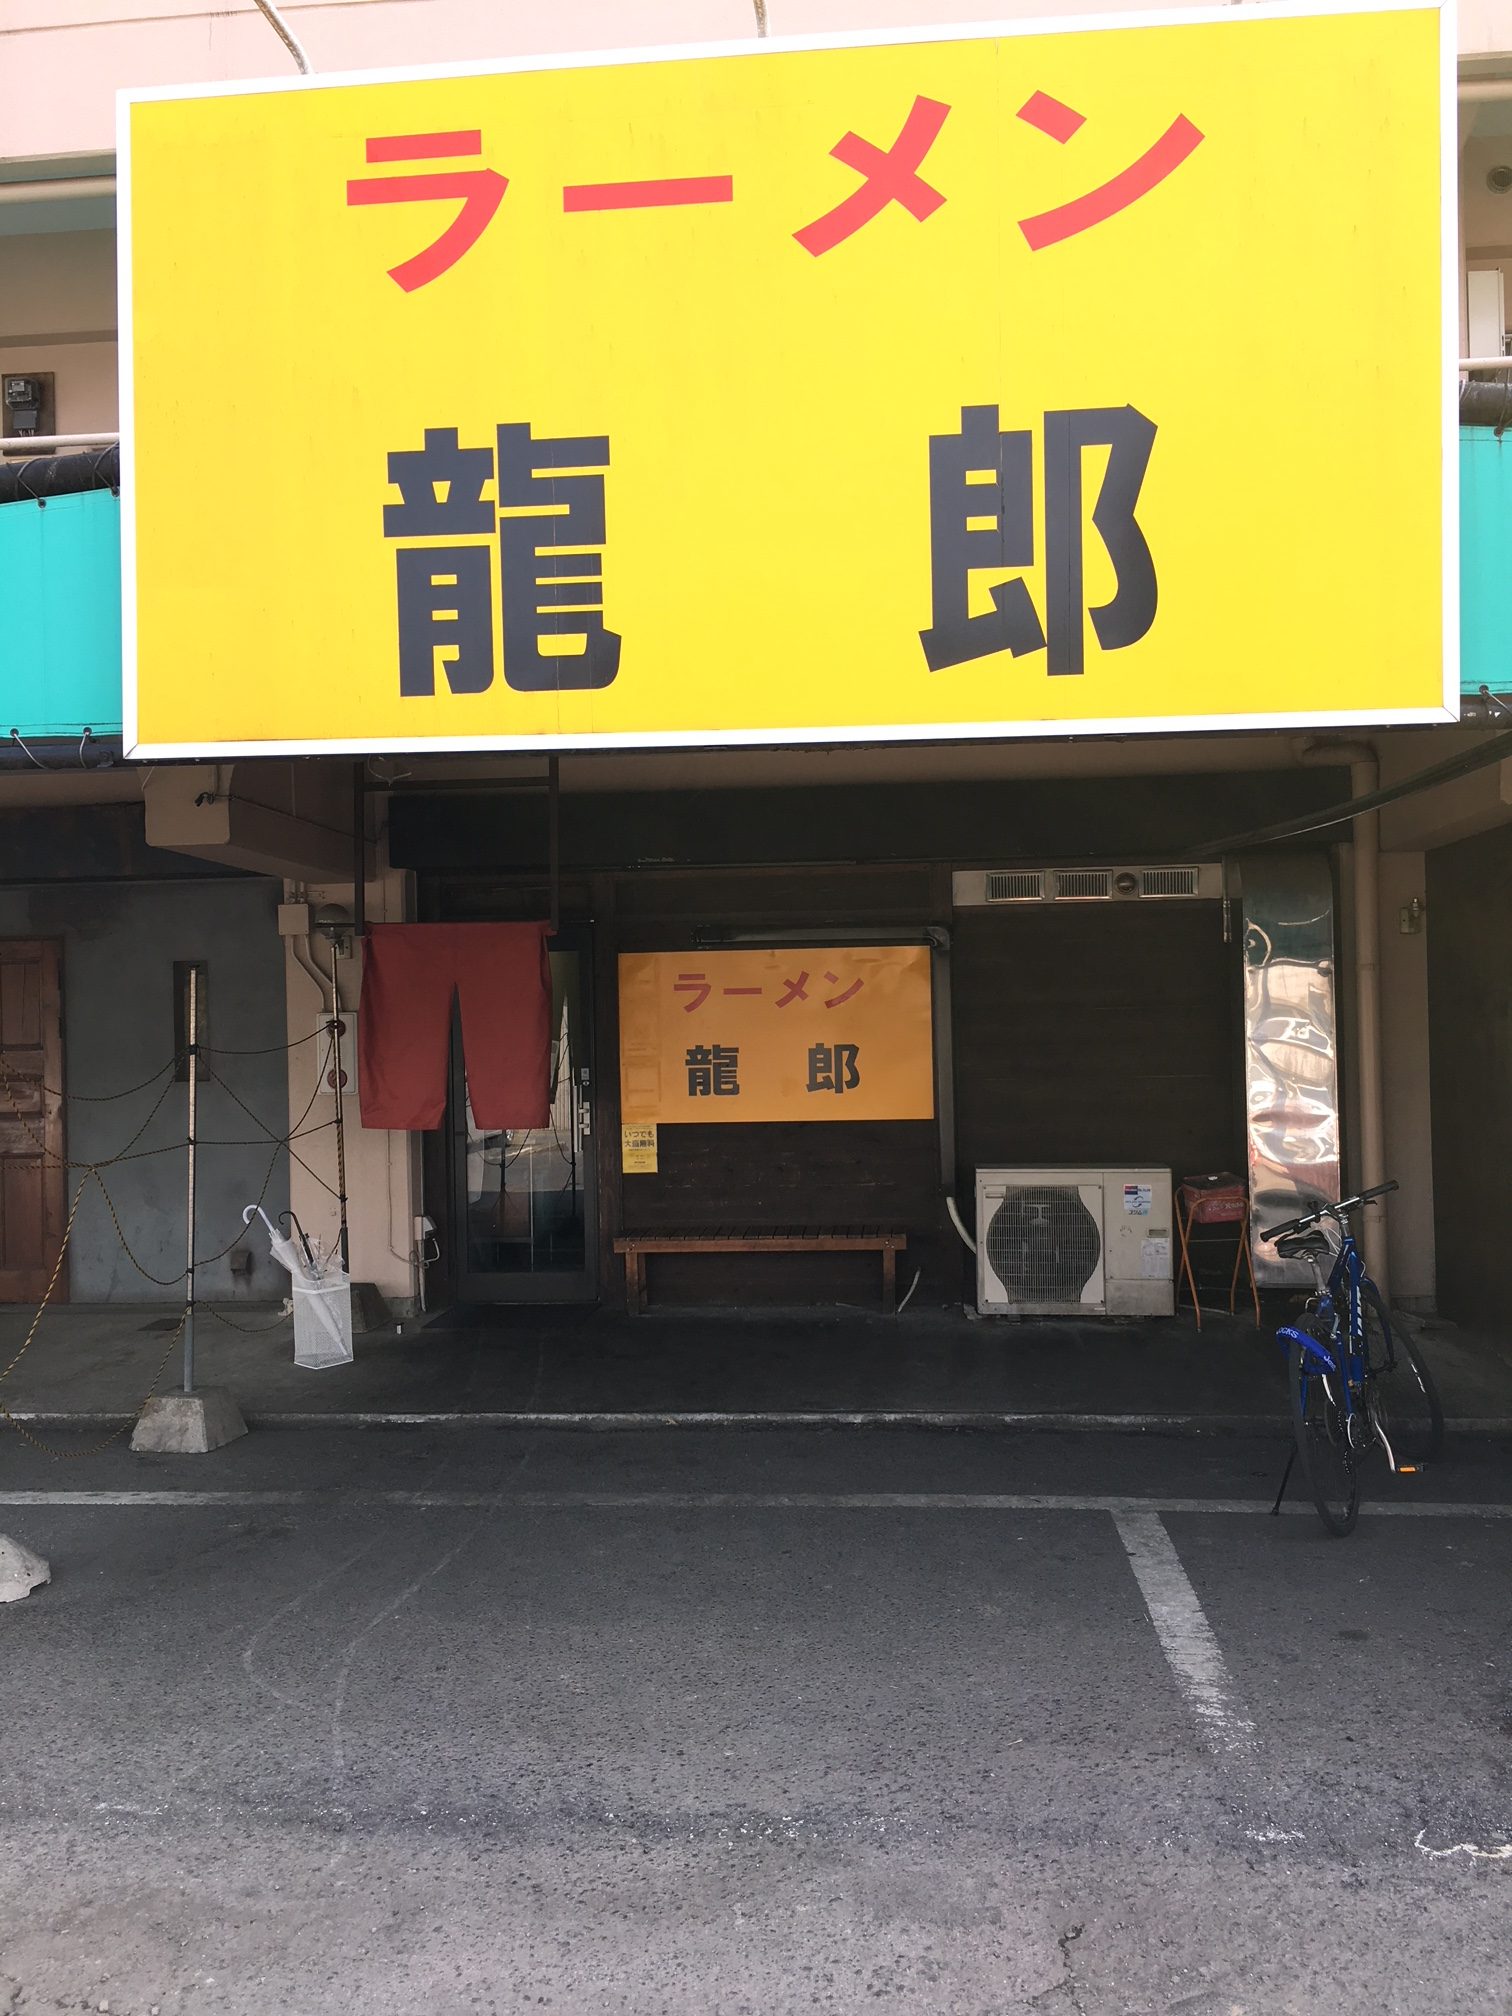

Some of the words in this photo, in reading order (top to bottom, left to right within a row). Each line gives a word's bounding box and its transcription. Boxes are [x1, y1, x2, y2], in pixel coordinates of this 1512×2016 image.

[347, 90, 1205, 293] ラーメン
[673, 971, 864, 1013] ラーメン
[624, 1130, 655, 1138] いつでも
